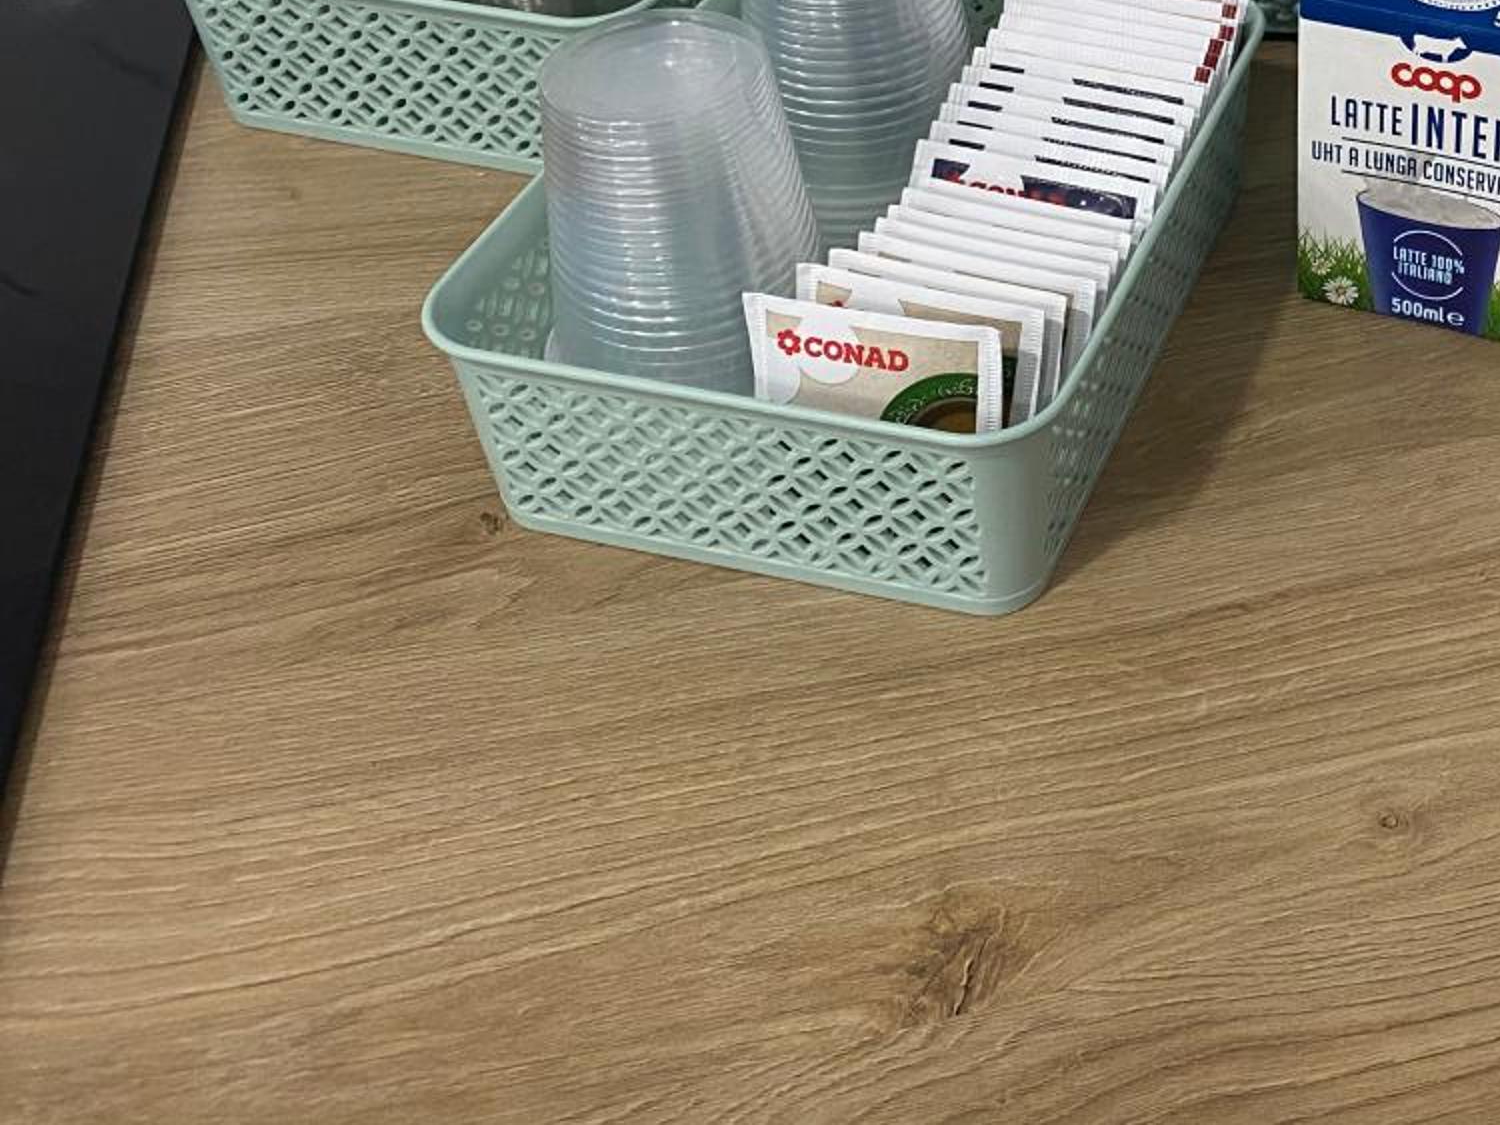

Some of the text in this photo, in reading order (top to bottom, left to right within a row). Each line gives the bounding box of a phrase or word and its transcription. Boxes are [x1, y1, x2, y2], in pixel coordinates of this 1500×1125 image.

[1391, 62, 1482, 104] coop
[1331, 95, 1403, 138] LATTE
[1311, 140, 1342, 165] UHT
[1349, 146, 1359, 168] A
[1365, 150, 1418, 178] LUNGA
[1393, 246, 1465, 275] LATTE 100%
[1398, 261, 1453, 285] ITALIANO
[1391, 297, 1444, 323] 500ml
[803, 335, 910, 373] CONAD
